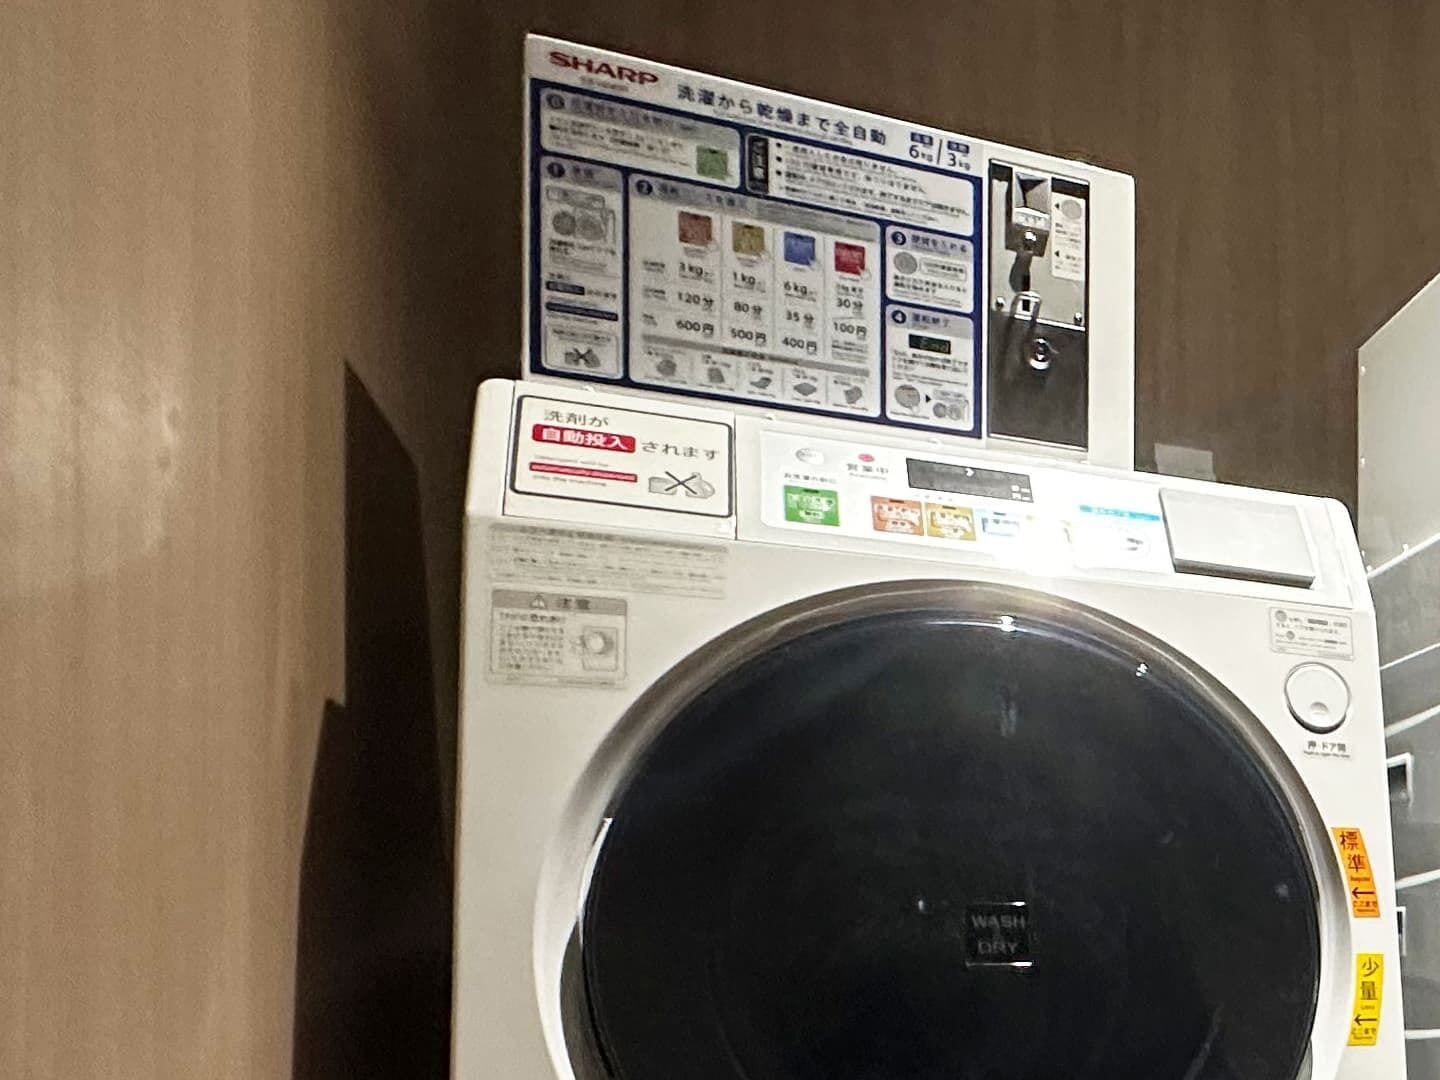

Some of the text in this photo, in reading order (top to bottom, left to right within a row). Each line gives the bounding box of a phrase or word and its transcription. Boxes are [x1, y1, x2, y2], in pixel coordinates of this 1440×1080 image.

[549, 51, 658, 85] SHARP
[677, 83, 886, 145] 洗濯から乾燥まで全自動
[909, 144, 934, 163] 6kg
[947, 152, 971, 172] 3kg
[733, 301, 763, 316] 80分
[785, 310, 814, 325] 35分
[675, 319, 714, 336] 600円
[730, 328, 767, 343] 500円
[833, 320, 867, 338] 100円
[781, 336, 817, 353] 400円
[544, 410, 609, 427] 洗剤が
[541, 427, 720, 460] 自動投入 されます
[1339, 831, 1366, 872] 標準
[971, 914, 1025, 928] WASH
[977, 940, 1019, 954] DRY
[1360, 957, 1379, 1001] 少量
